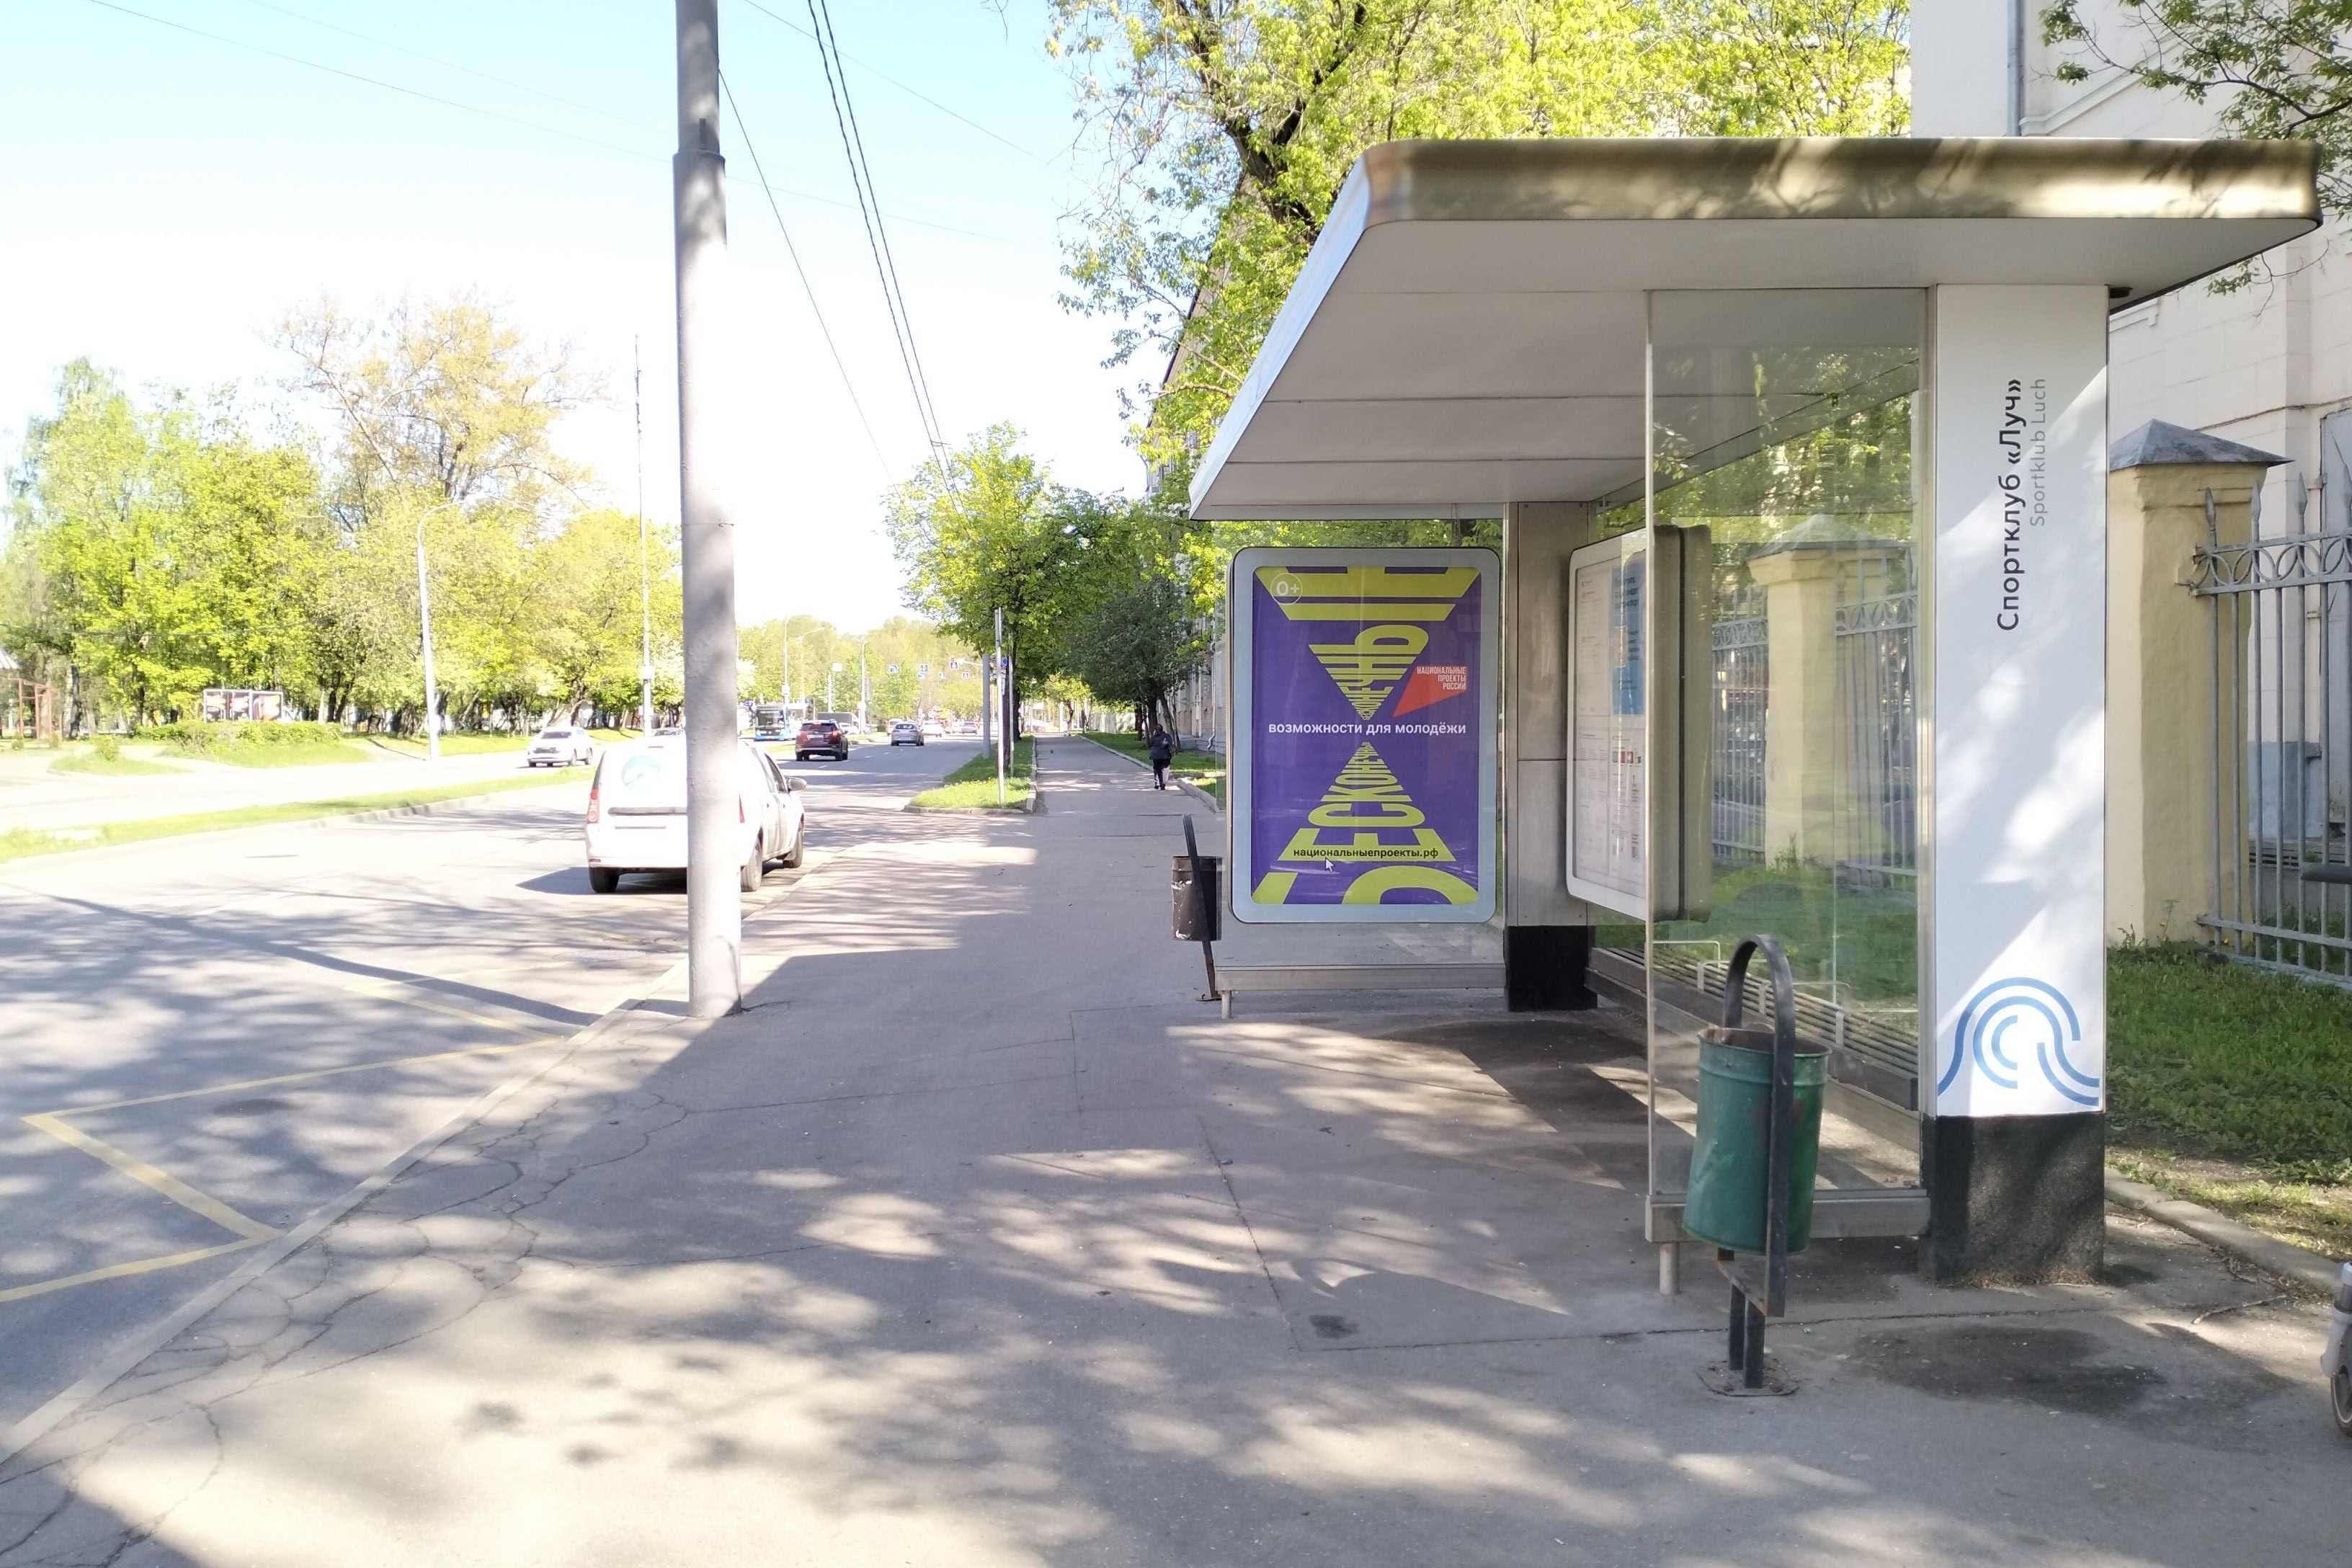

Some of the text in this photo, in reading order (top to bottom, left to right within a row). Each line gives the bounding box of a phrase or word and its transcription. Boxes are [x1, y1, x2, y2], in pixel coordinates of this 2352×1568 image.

[2029, 378, 2046, 526] Sportklub Luch
[1997, 378, 2026, 631] Спортклуб «Луч»
[1275, 581, 1301, 597] 0+
[1417, 666, 1467, 675] НАЦИОНАЛЬНЫЕ
[1443, 682, 1466, 690] РОССИИ
[1268, 721, 1466, 736] возможности для молодёжи
[1293, 847, 1439, 859] национальныепроекты.рф
